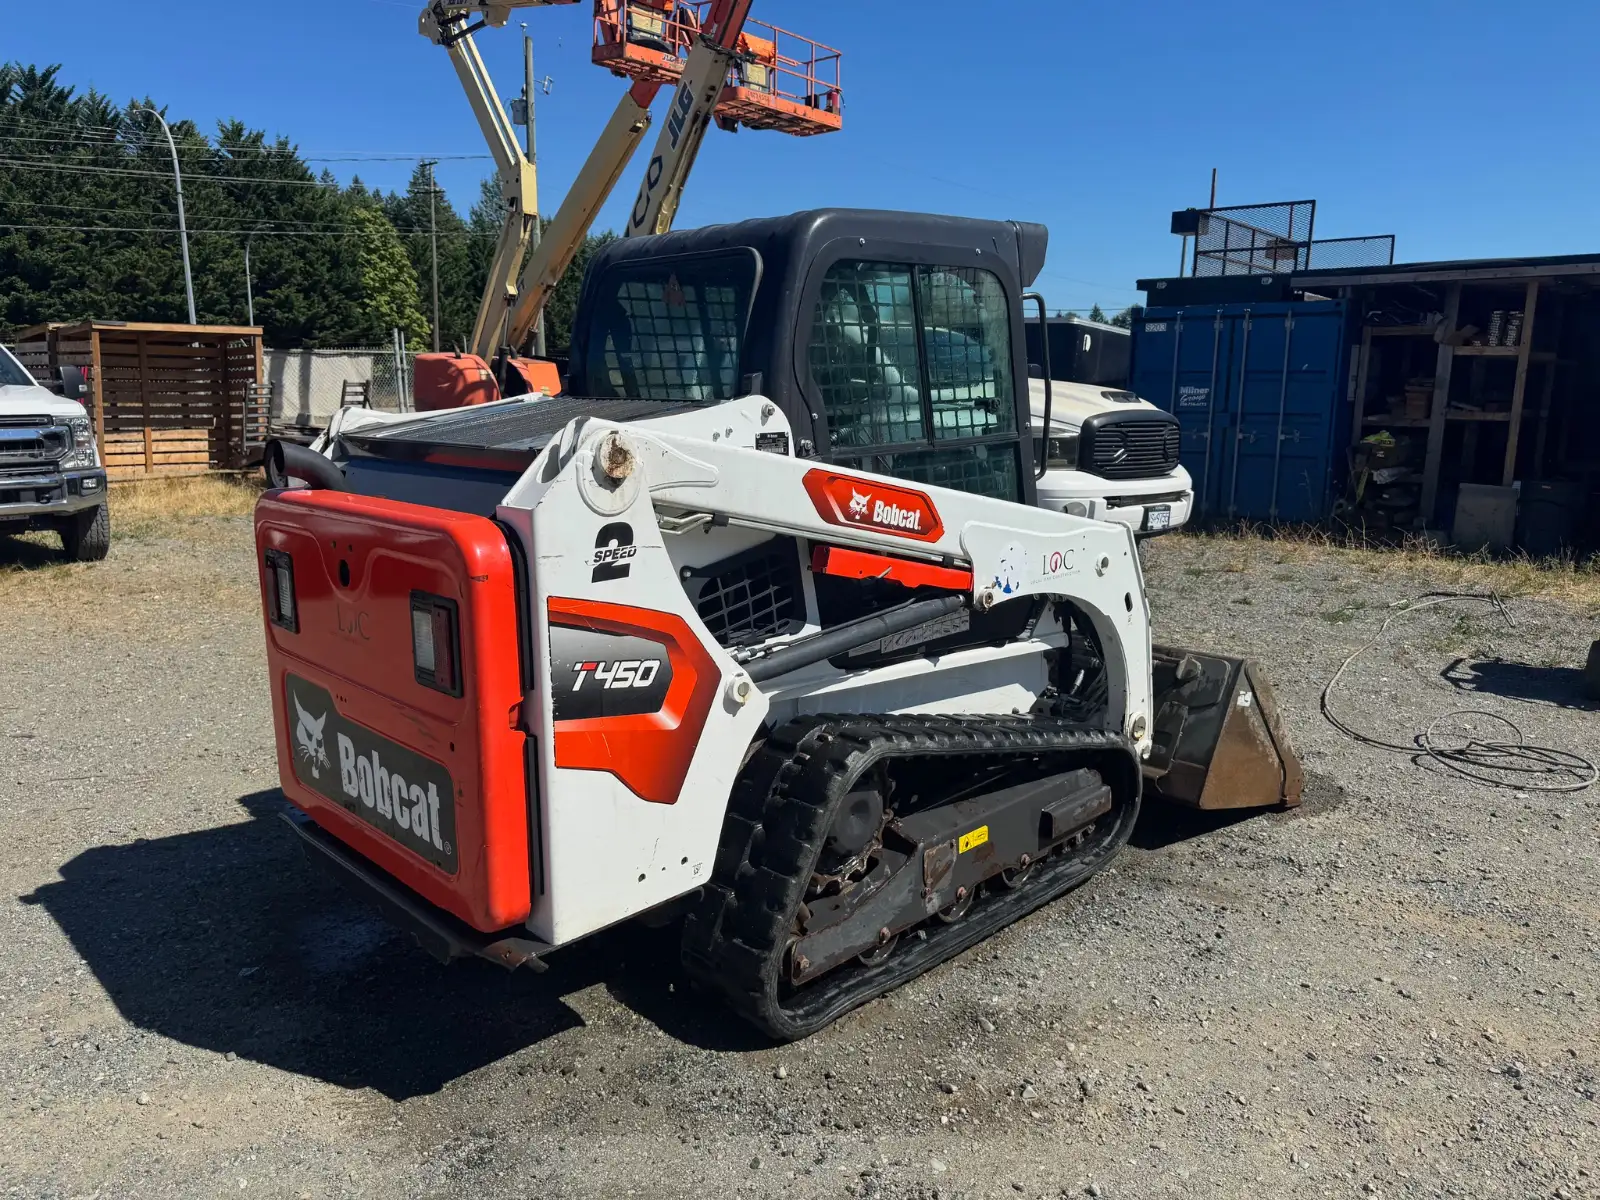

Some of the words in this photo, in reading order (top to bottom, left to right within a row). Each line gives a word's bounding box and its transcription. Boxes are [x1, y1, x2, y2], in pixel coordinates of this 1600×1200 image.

[668, 81, 694, 150] JLG
[1180, 386, 1209, 394] Milner
[873, 500, 920, 530] Bobcat
[594, 546, 637, 563] SPEED
[572, 660, 660, 692] T450
[337, 732, 444, 850] Bobcat
